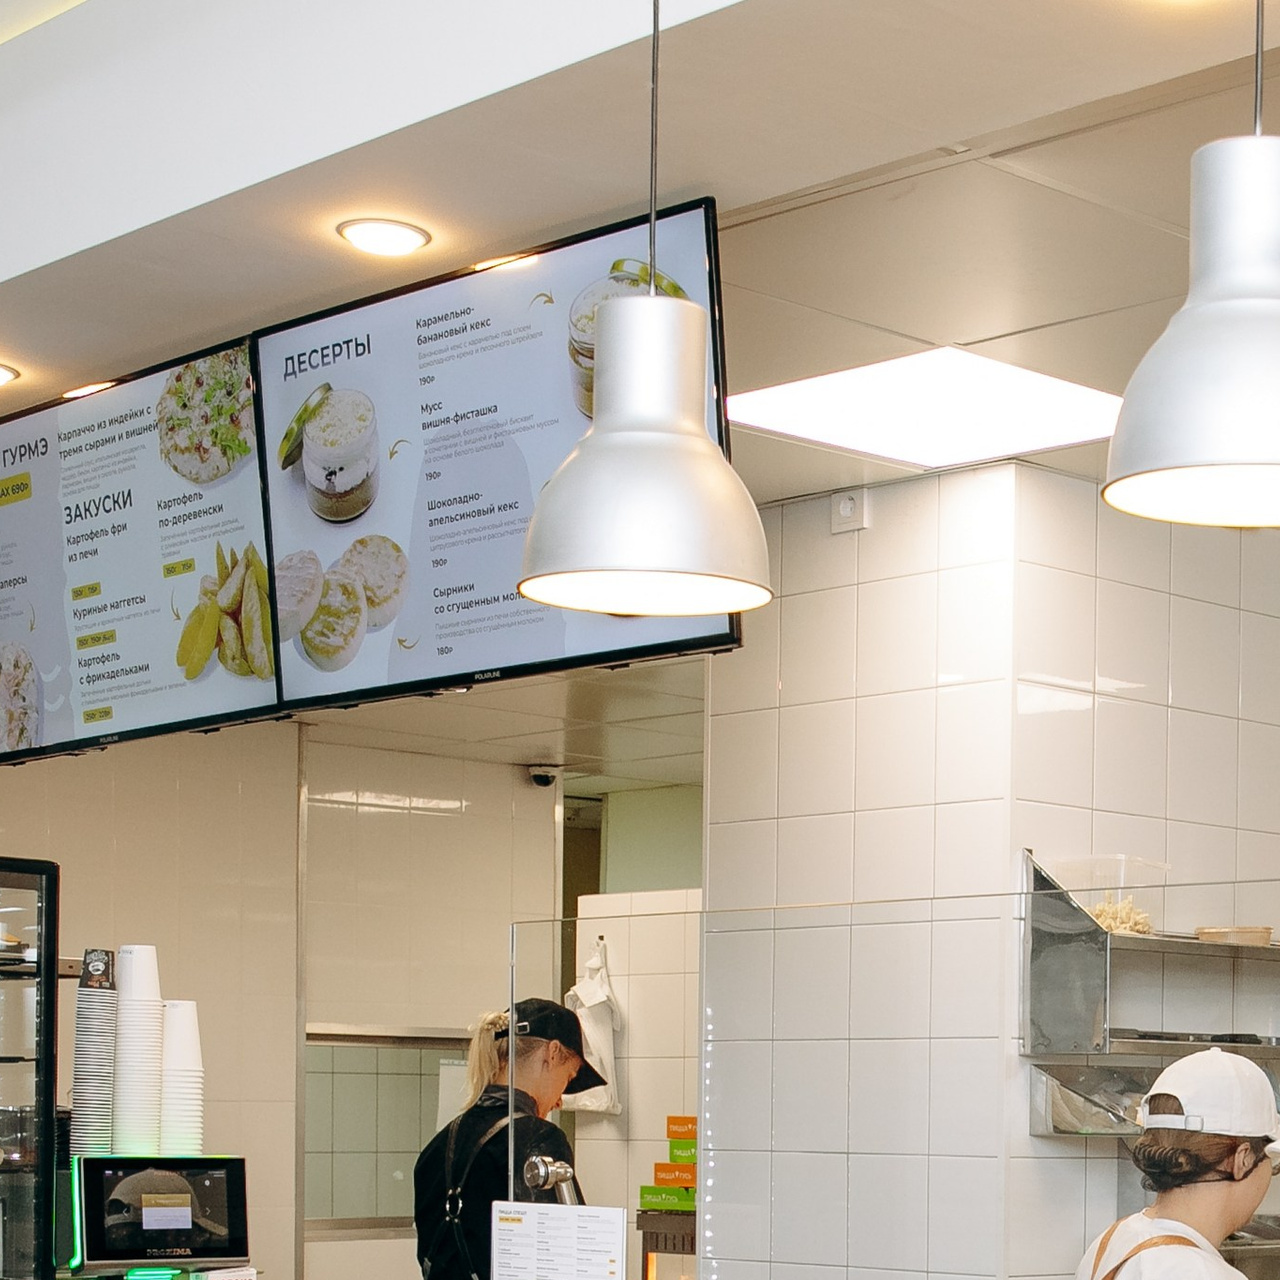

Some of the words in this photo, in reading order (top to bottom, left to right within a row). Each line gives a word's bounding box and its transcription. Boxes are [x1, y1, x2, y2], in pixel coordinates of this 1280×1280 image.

[416, 307, 475, 329] Карамельно-
[417, 322, 468, 346] банановый
[470, 318, 491, 331] кекс
[283, 333, 371, 381] ДЕСЕРТЫ
[420, 401, 443, 415] Мусс
[422, 404, 498, 431] вишня-фисташка
[57, 426, 95, 444] Карпаччо
[97, 421, 107, 430] из
[108, 409, 144, 427] индейки
[147, 406, 151, 414] с
[2, 437, 48, 468] ГУРМЭ
[59, 445, 83, 461] тремя
[84, 435, 116, 452] сырами
[118, 433, 124, 442] и
[125, 420, 159, 440] вишней
[64, 488, 133, 525] ЗАКУСКИ
[156, 491, 204, 511] Картофель
[427, 492, 483, 511] Шоколадно-
[158, 503, 224, 529] по-деревенски
[428, 503, 496, 528] апельсиновый
[497, 501, 519, 513] кекс
[66, 528, 109, 546] Картофель
[110, 523, 128, 537] фри
[68, 553, 78, 563] из
[79, 548, 99, 561] печи
[433, 583, 475, 599] Сырники
[434, 606, 445, 614] со
[446, 595, 500, 614] сгущенным
[502, 591, 527, 602] моло
[72, 604, 108, 620] Куриные
[110, 594, 147, 610] наггетсы
[77, 651, 121, 669] Картофель
[79, 676, 85, 685] с
[85, 663, 150, 686] фрикадельками
